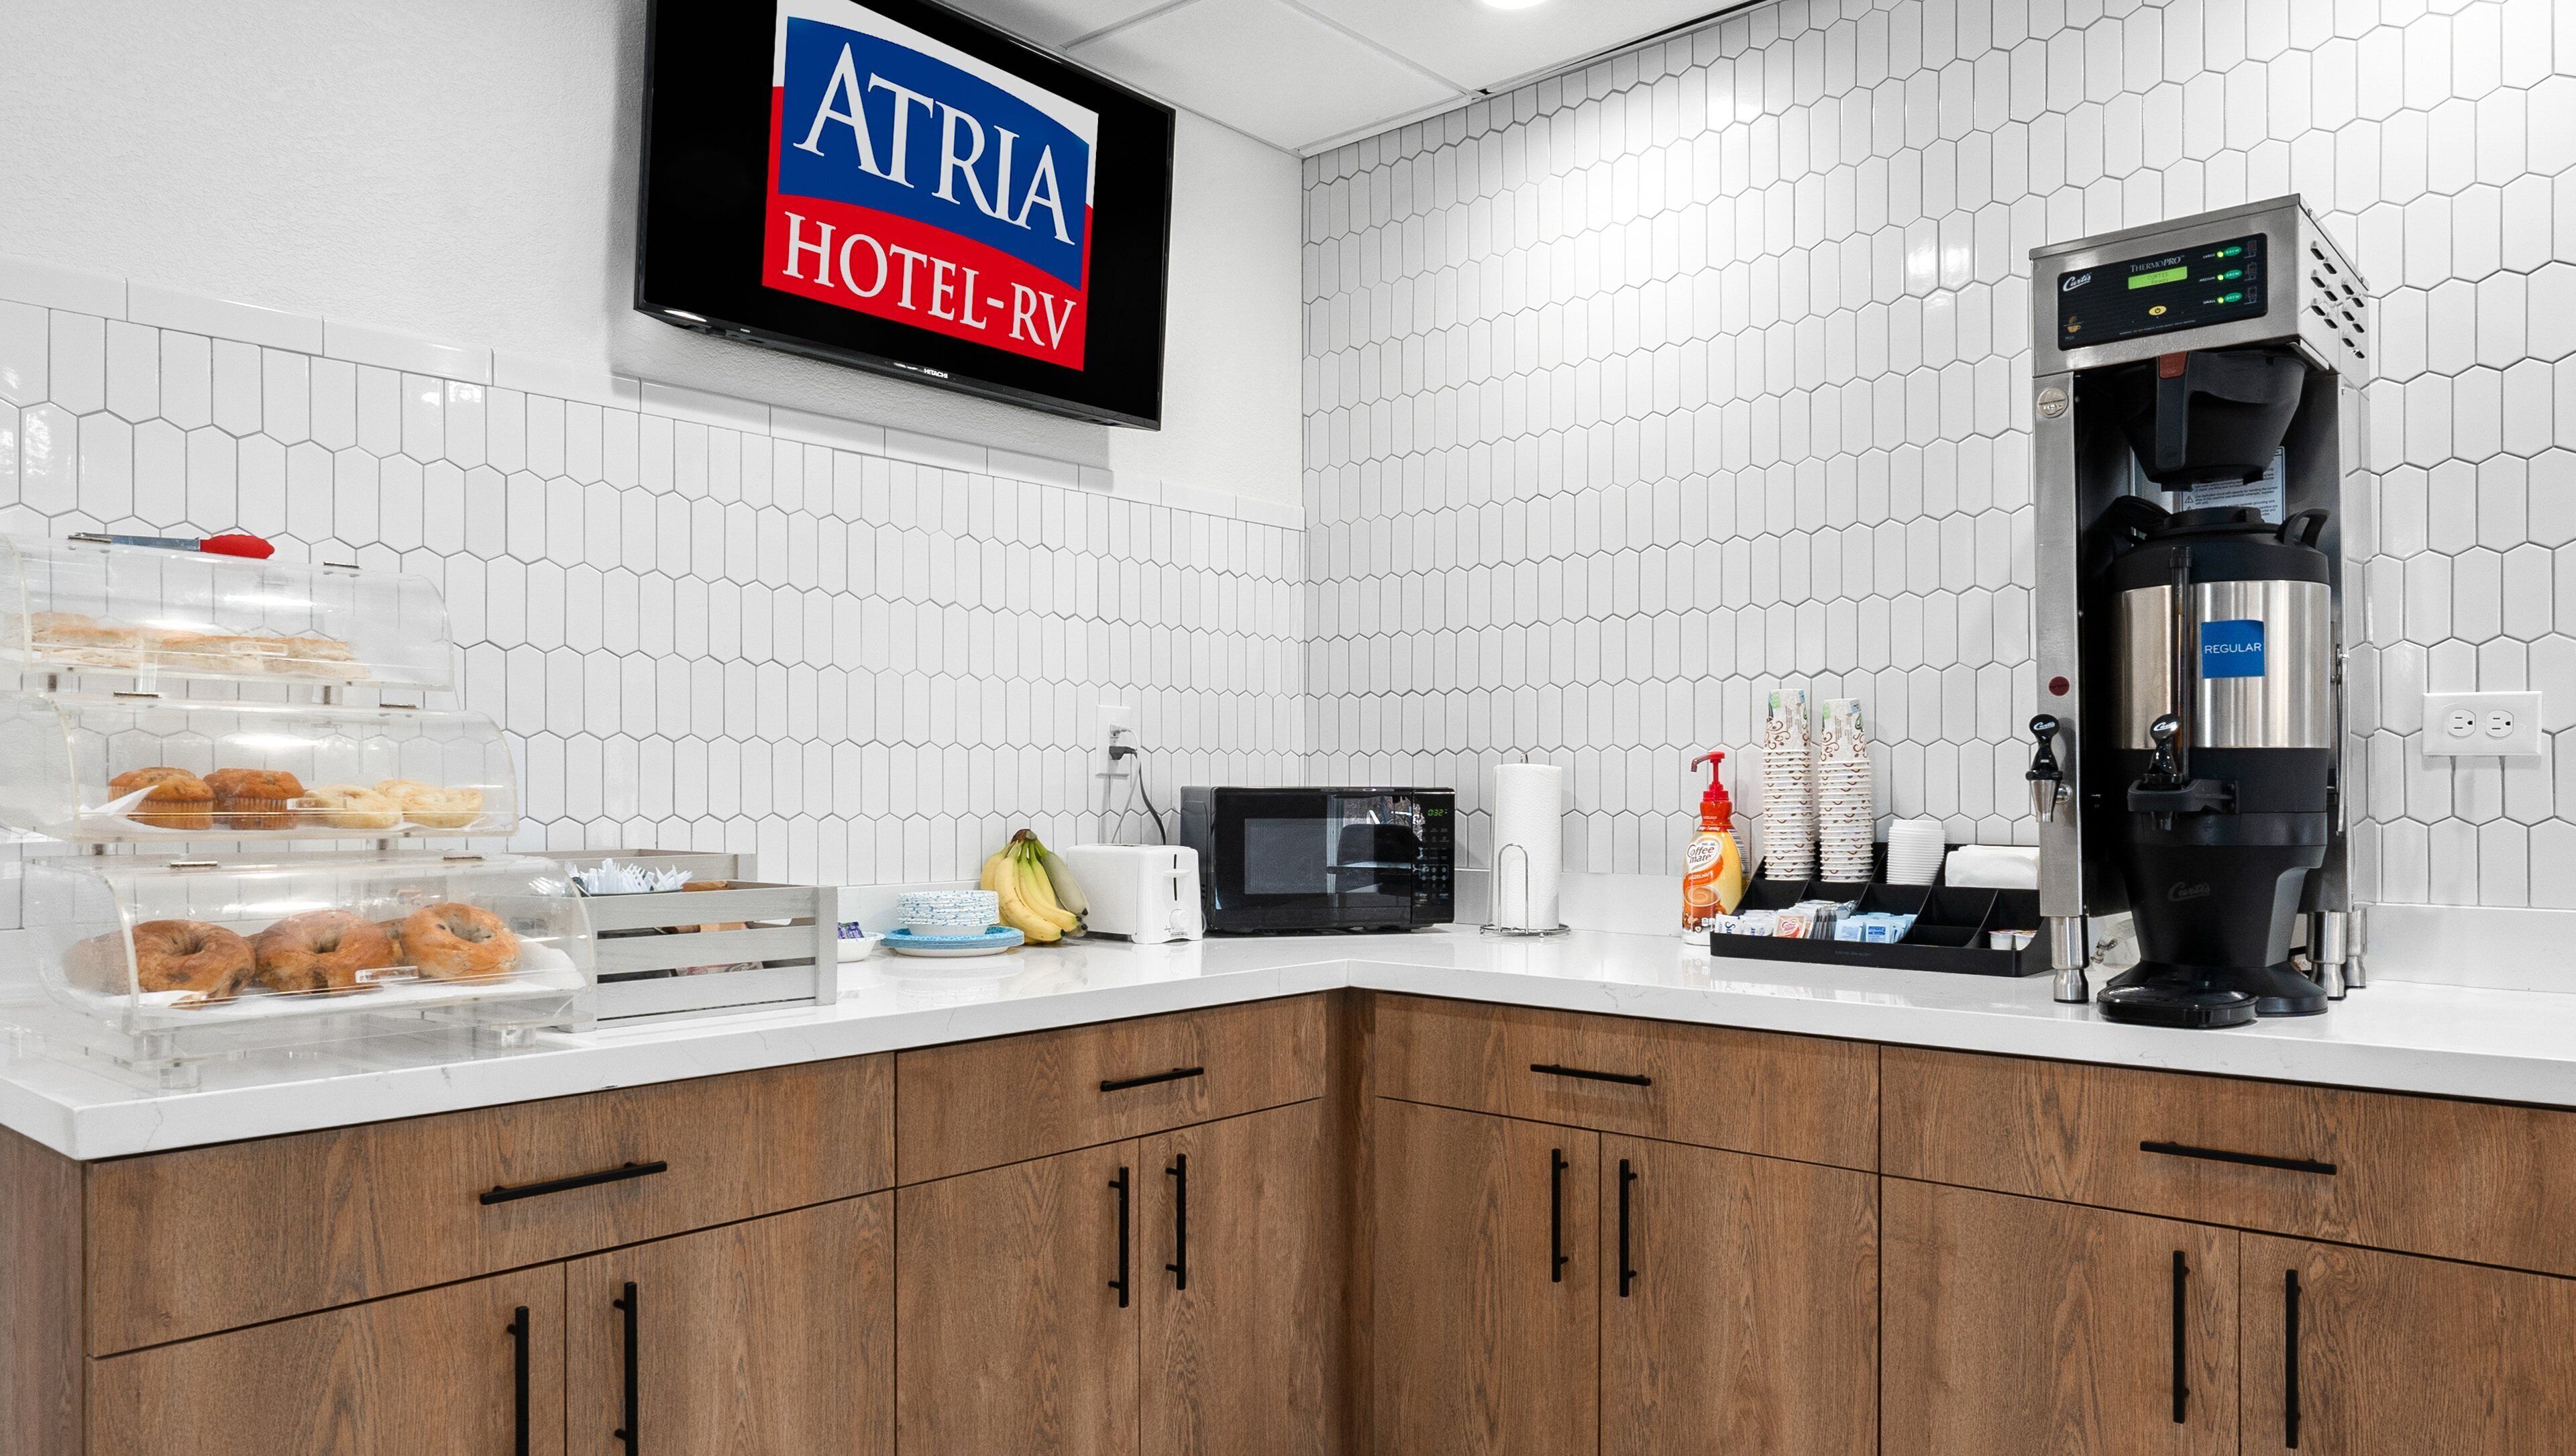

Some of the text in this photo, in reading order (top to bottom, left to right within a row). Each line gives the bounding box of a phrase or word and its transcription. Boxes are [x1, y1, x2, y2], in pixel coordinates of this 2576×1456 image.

[793, 42, 1075, 245] ATRIA
[782, 211, 1077, 350] HOTEL-RV
[2063, 273, 2091, 292] Curtis
[924, 368, 948, 378] HITACHI
[2204, 642, 2262, 654] REGULAR
[1687, 844, 1715, 857] Coffee
[1689, 854, 1711, 864] mate
[2167, 881, 2210, 901] Curtis
